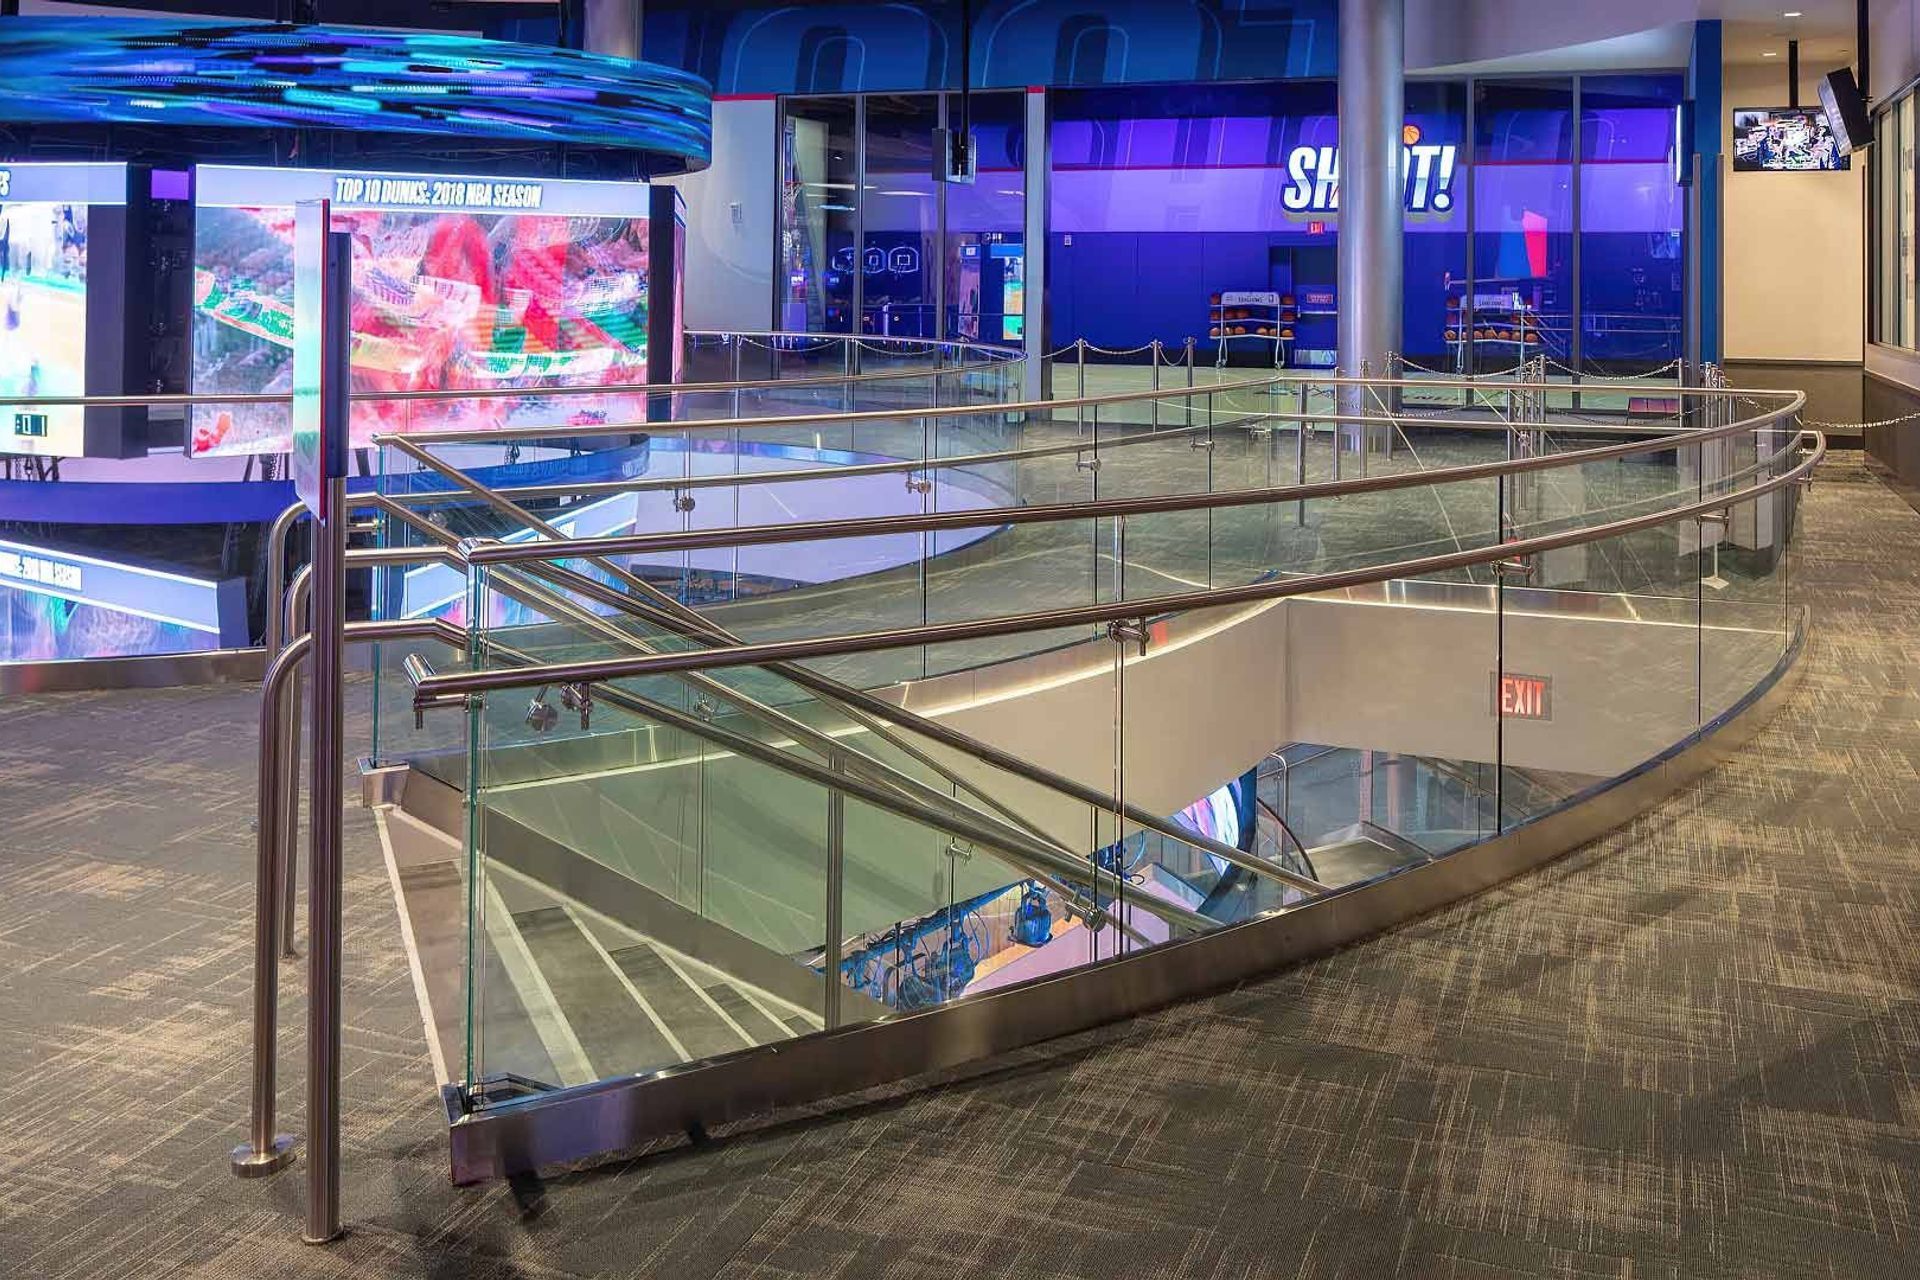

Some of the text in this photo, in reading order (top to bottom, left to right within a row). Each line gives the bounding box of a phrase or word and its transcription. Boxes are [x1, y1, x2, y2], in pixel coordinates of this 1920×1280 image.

[336, 178, 543, 209] TOP 10 DUNKS: 2018 NBA SEASON
[1283, 145, 1457, 211] SHT!
[1502, 678, 1545, 716] EXIT
